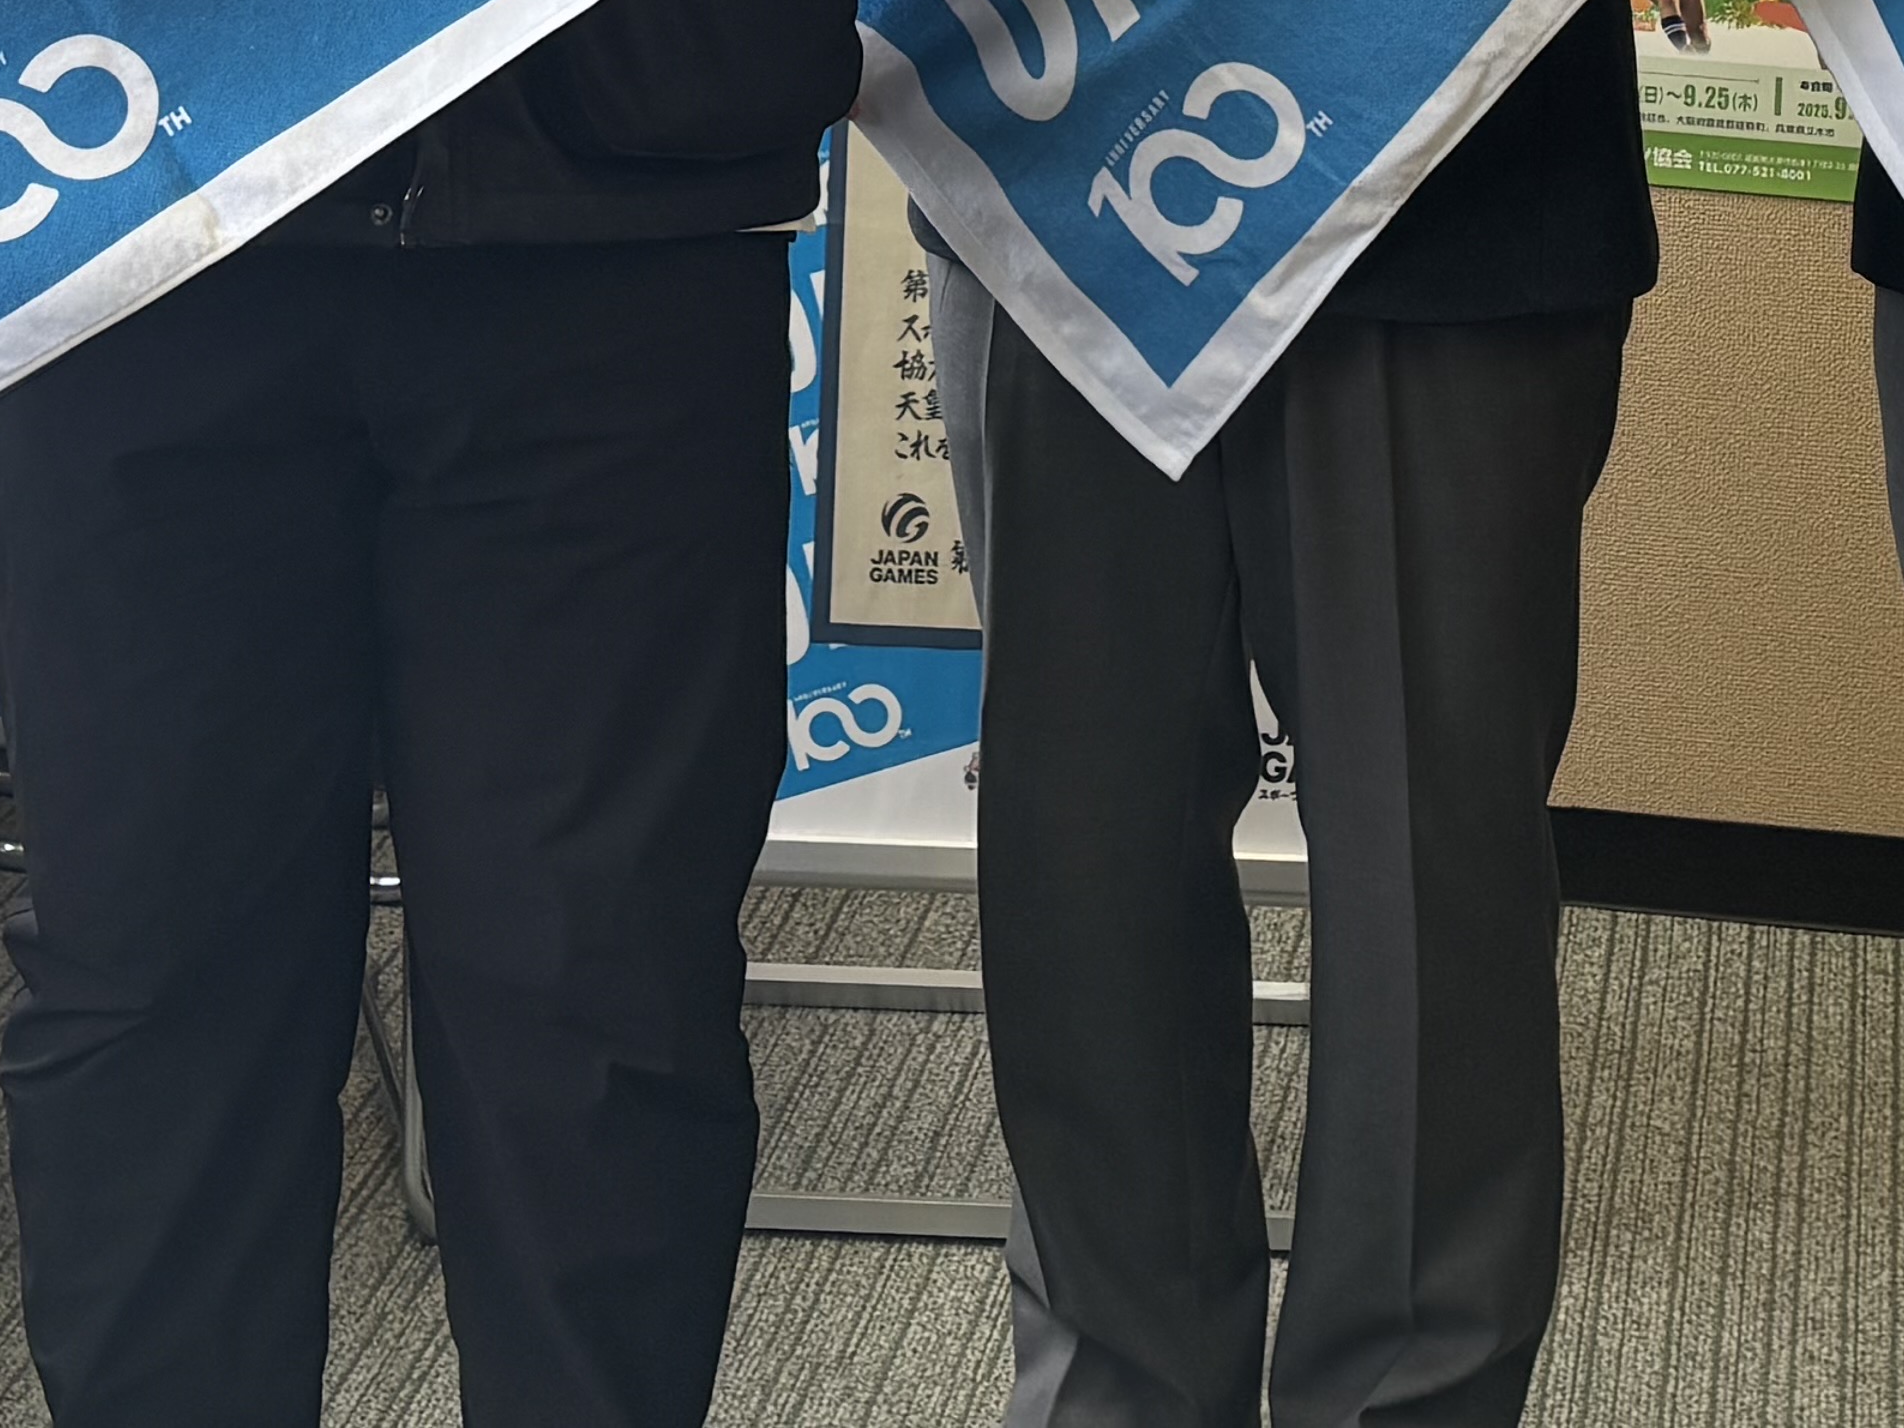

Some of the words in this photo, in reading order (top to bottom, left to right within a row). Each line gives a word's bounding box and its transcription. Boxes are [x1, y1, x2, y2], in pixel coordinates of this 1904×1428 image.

[1103, 87, 1173, 171] ANNIVERSARY
[870, 549, 939, 568] JAPAN
[869, 567, 939, 585] GAMES
